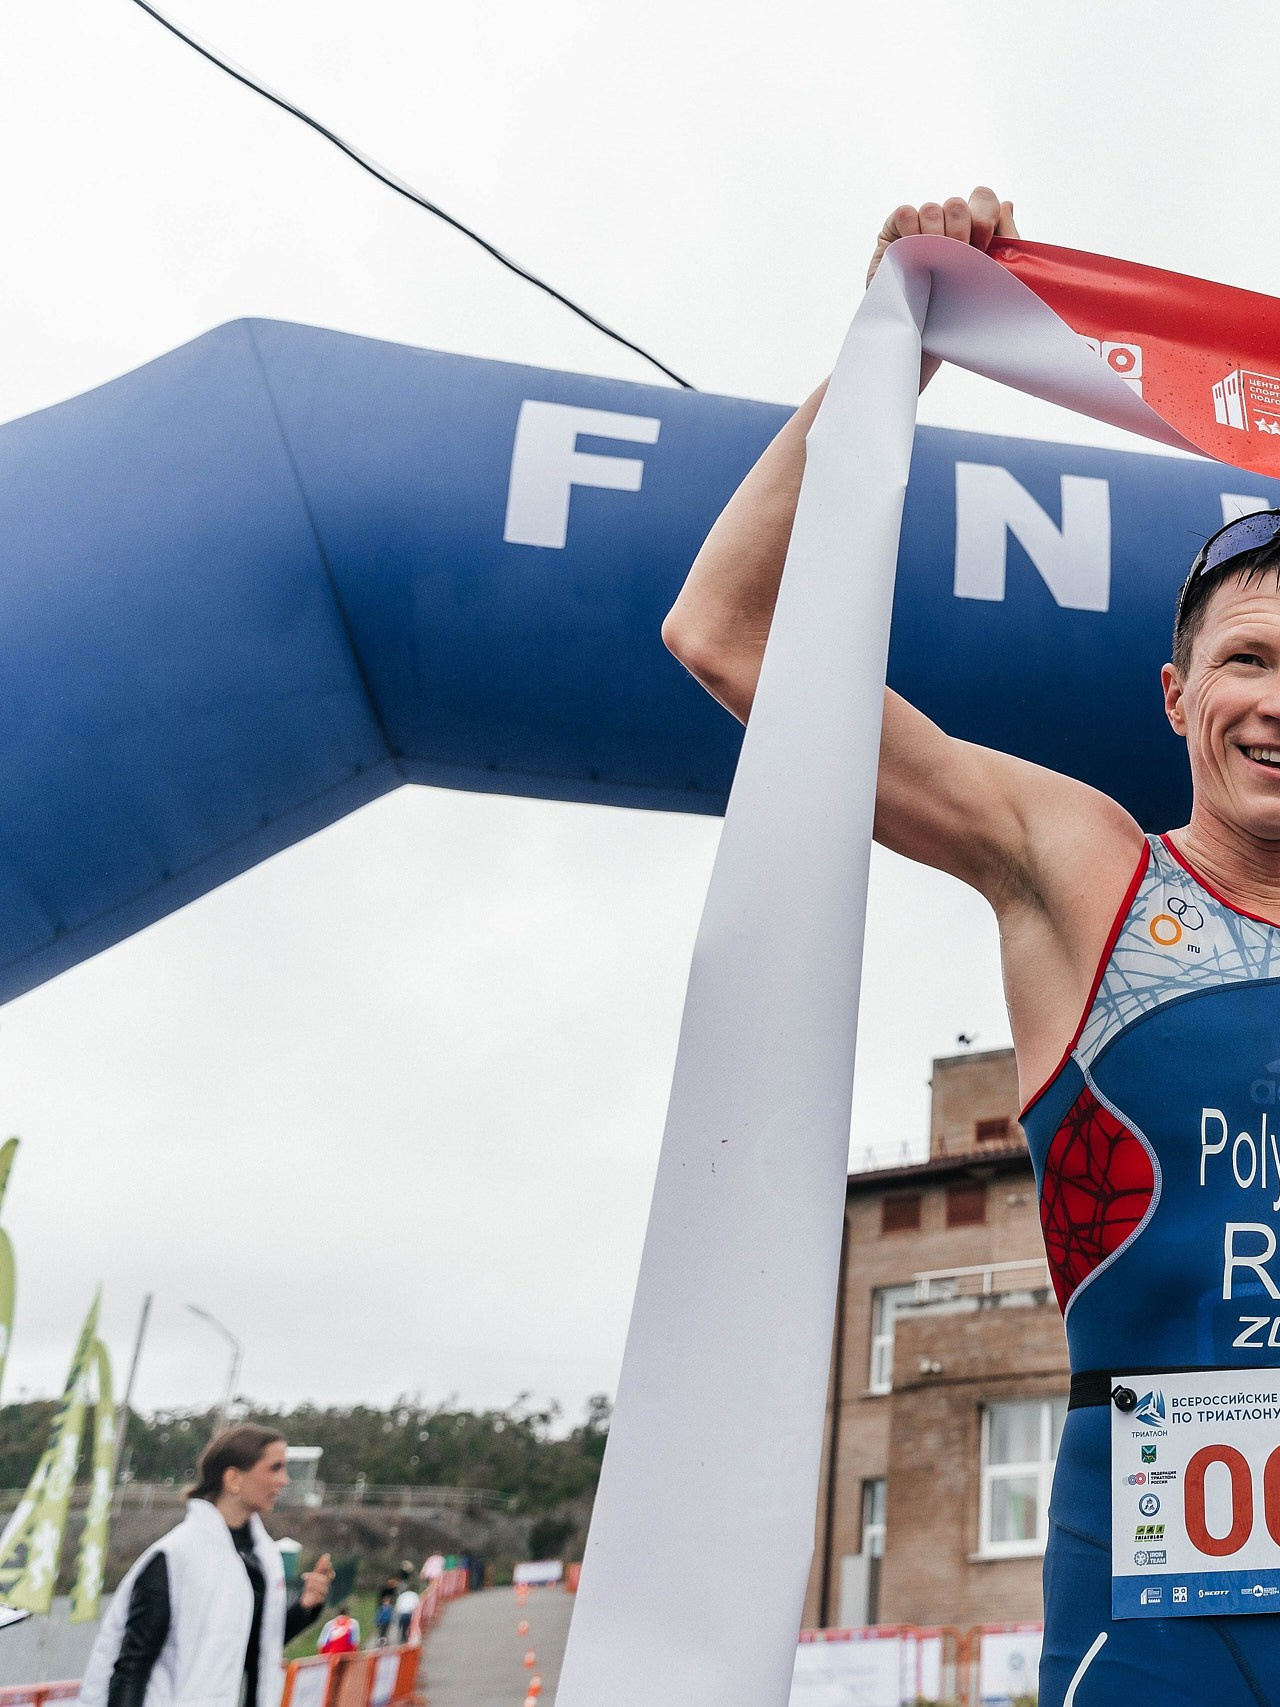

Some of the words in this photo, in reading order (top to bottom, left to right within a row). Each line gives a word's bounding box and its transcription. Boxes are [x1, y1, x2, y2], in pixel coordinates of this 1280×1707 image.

[1249, 379, 1280, 390] ЦЕНТР
[1187, 943, 1201, 954] ITU
[1171, 1392, 1278, 1407] ВСЕРОССИЙСКИЕ
[1171, 1411, 1192, 1424] ПО
[1131, 1430, 1168, 1438] ТРИАТЛОН
